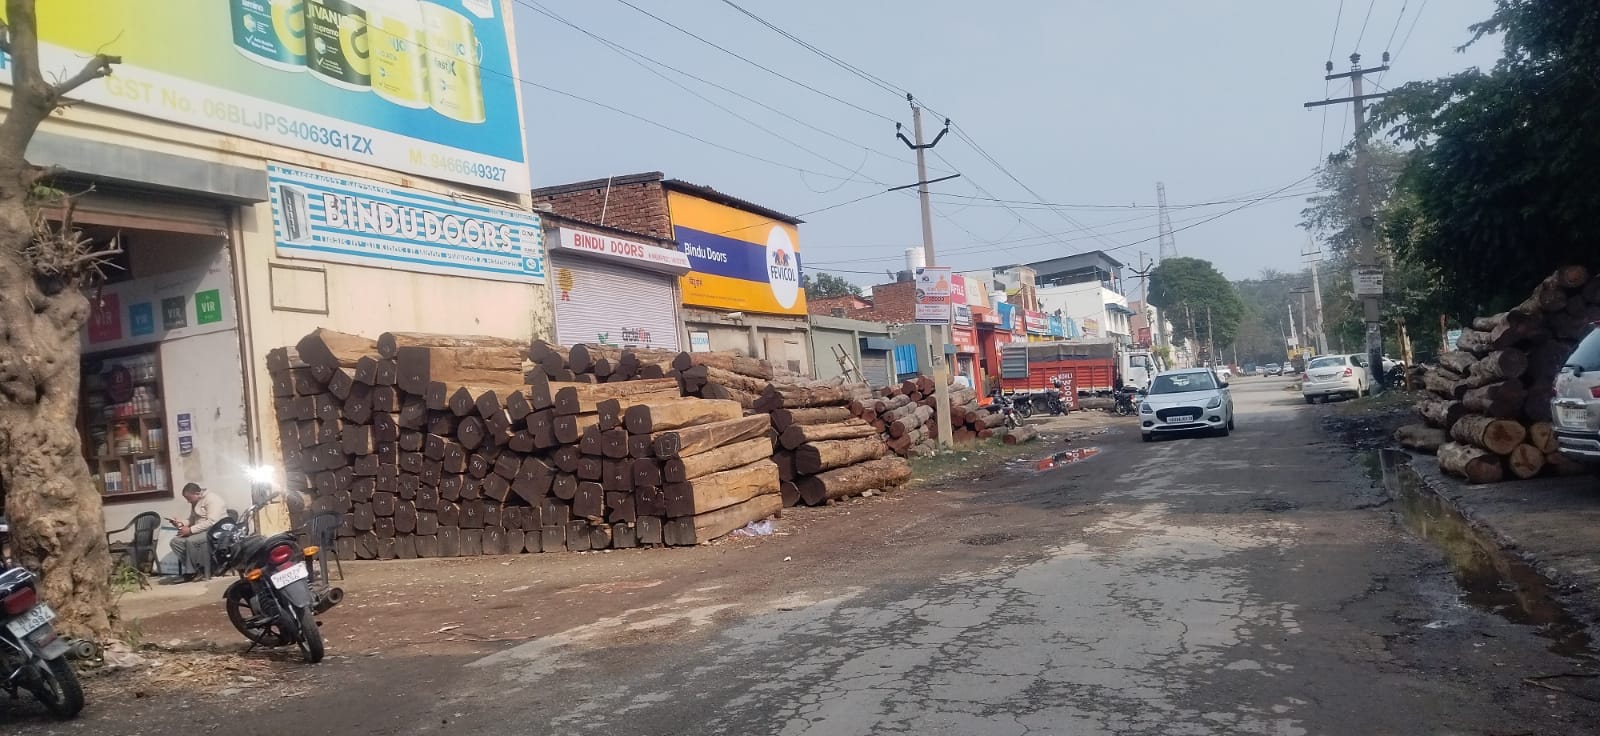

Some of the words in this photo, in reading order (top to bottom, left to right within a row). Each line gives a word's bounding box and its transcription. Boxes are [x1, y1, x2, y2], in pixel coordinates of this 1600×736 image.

[106, 75, 154, 101] GST
[160, 87, 198, 113] No.
[203, 100, 374, 156] 06BLJPS4063G1ZX
[431, 152, 507, 182] 9466649327
[322, 192, 419, 240] BINDU
[422, 210, 513, 253] DOORS
[574, 233, 605, 252] BINDU
[610, 241, 645, 258] DOORS
[684, 242, 706, 259] Bindu
[706, 247, 728, 263] Doors
[770, 265, 797, 282] FEVICOL
[167, 307, 182, 319] VIR
[201, 301, 216, 313] VIR
